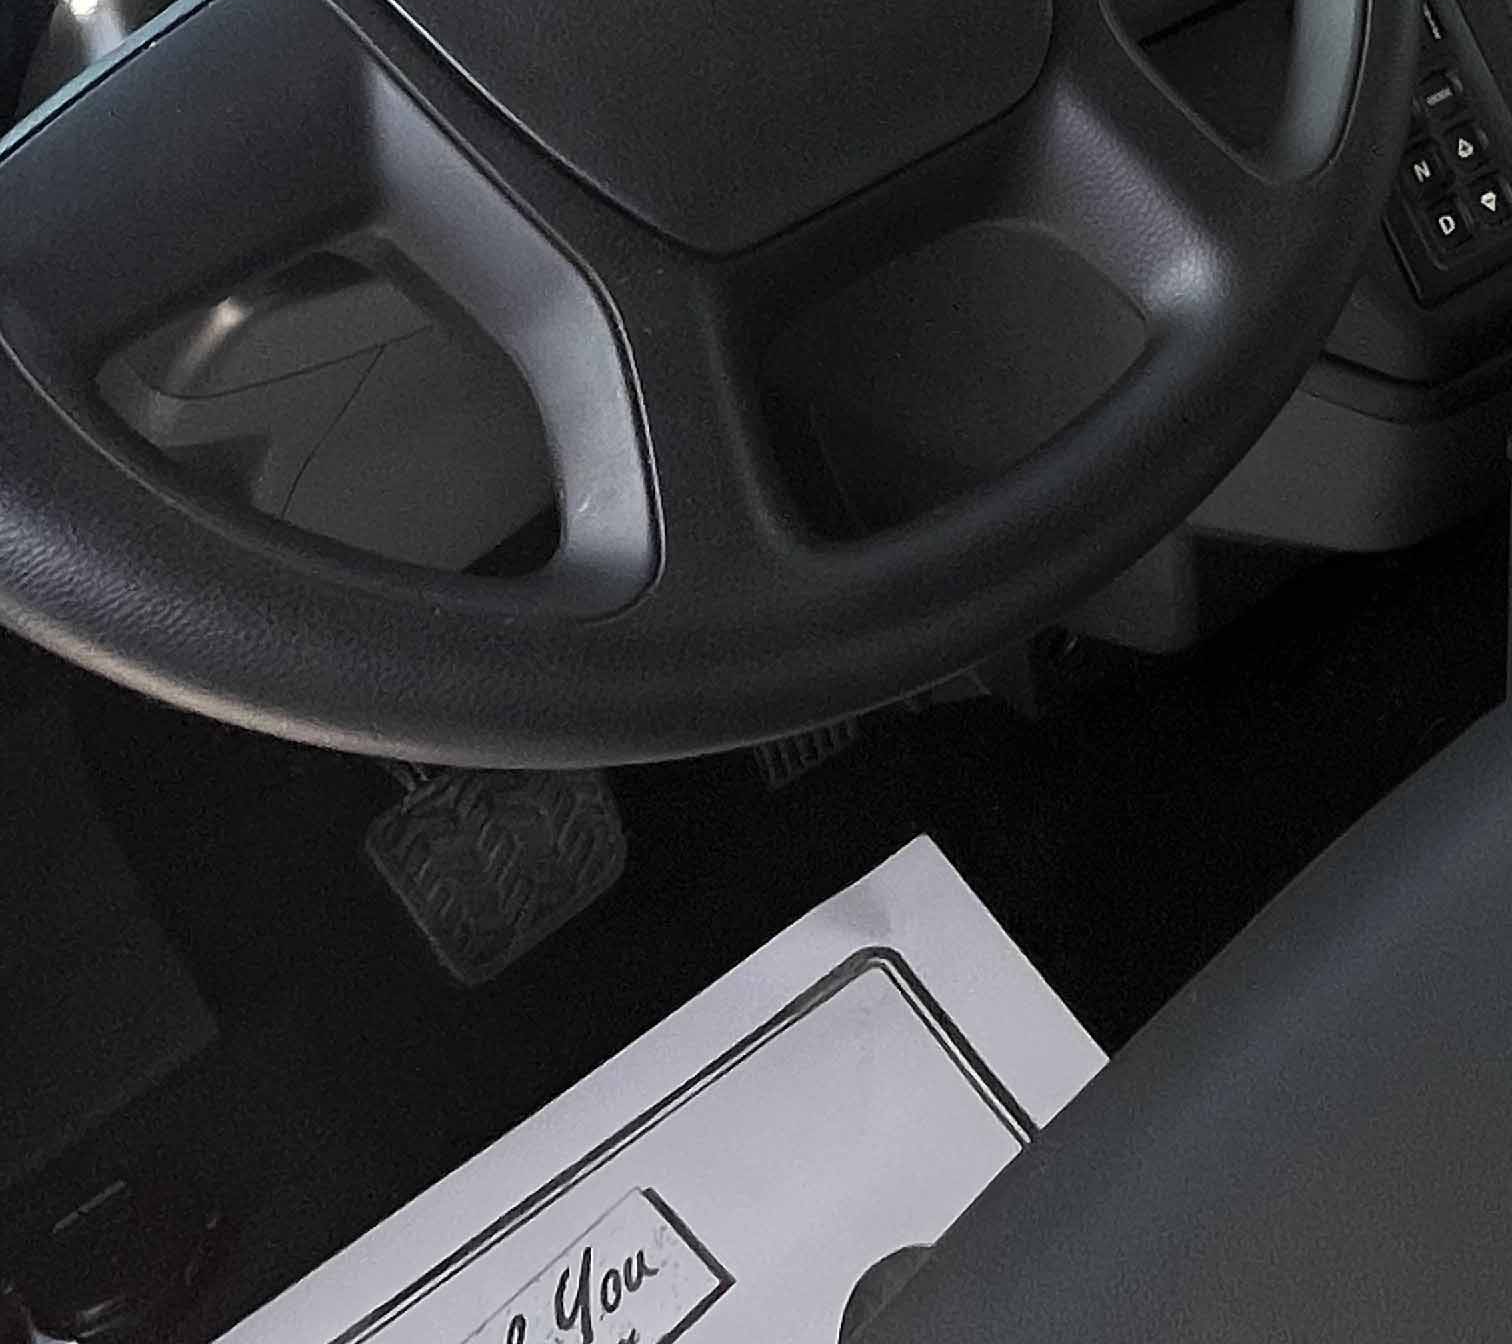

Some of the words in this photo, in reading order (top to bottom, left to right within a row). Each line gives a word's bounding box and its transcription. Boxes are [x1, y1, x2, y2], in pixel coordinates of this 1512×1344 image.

[1413, 160, 1432, 183] N
[1438, 215, 1456, 236] D
[554, 1246, 660, 1344] You
